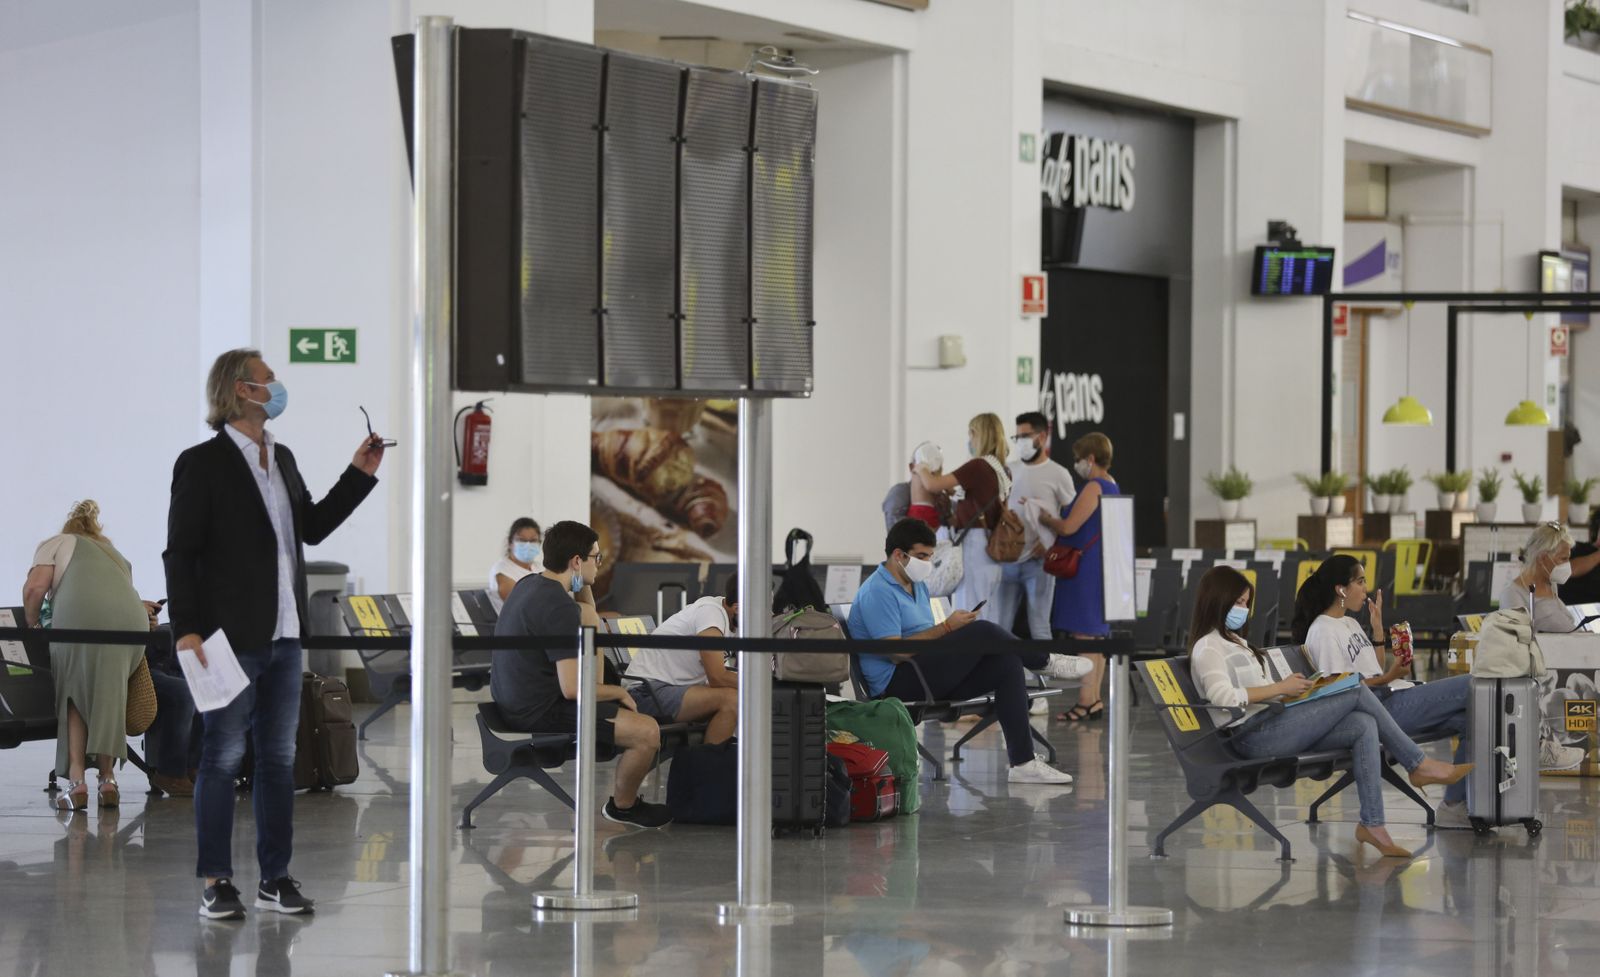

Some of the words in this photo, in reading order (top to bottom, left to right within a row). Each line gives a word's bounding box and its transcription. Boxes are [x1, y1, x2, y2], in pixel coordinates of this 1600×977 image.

[1041, 131, 1072, 208] afe
[1073, 134, 1136, 212] pans
[1054, 370, 1104, 440] pans
[1569, 705, 1592, 714] 4K
